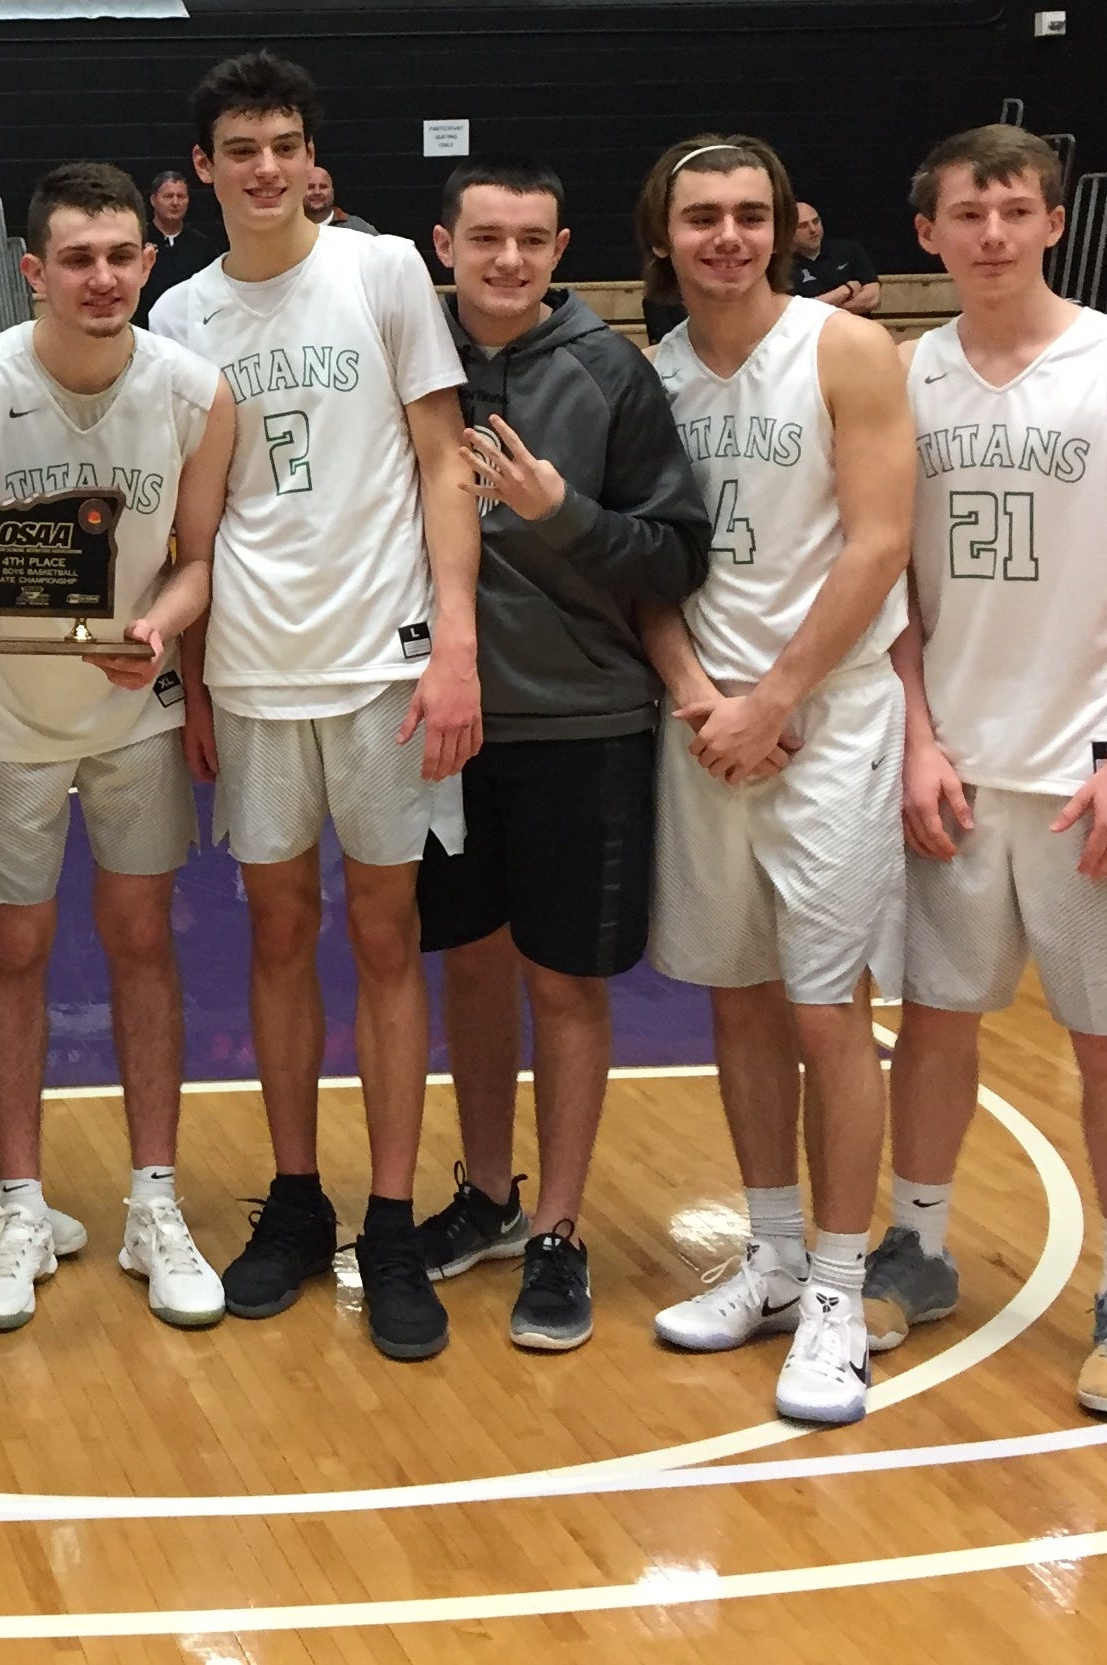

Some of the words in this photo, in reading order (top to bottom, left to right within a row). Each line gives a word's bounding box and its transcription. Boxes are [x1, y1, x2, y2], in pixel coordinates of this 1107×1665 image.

[221, 346, 359, 405] ITANS
[264, 410, 313, 496] 2
[676, 415, 803, 467] ITANS
[916, 423, 1091, 483] TITANS
[5, 463, 164, 514] TITANS
[710, 479, 757, 564] 4
[949, 490, 1039, 582] 21
[2, 556, 24, 566] 4TH
[29, 557, 66, 567] PLACE
[2, 567, 24, 576] BOYS
[27, 568, 79, 577] BASKETBALL
[18, 576, 77, 585] CHAMPIONSHIP
